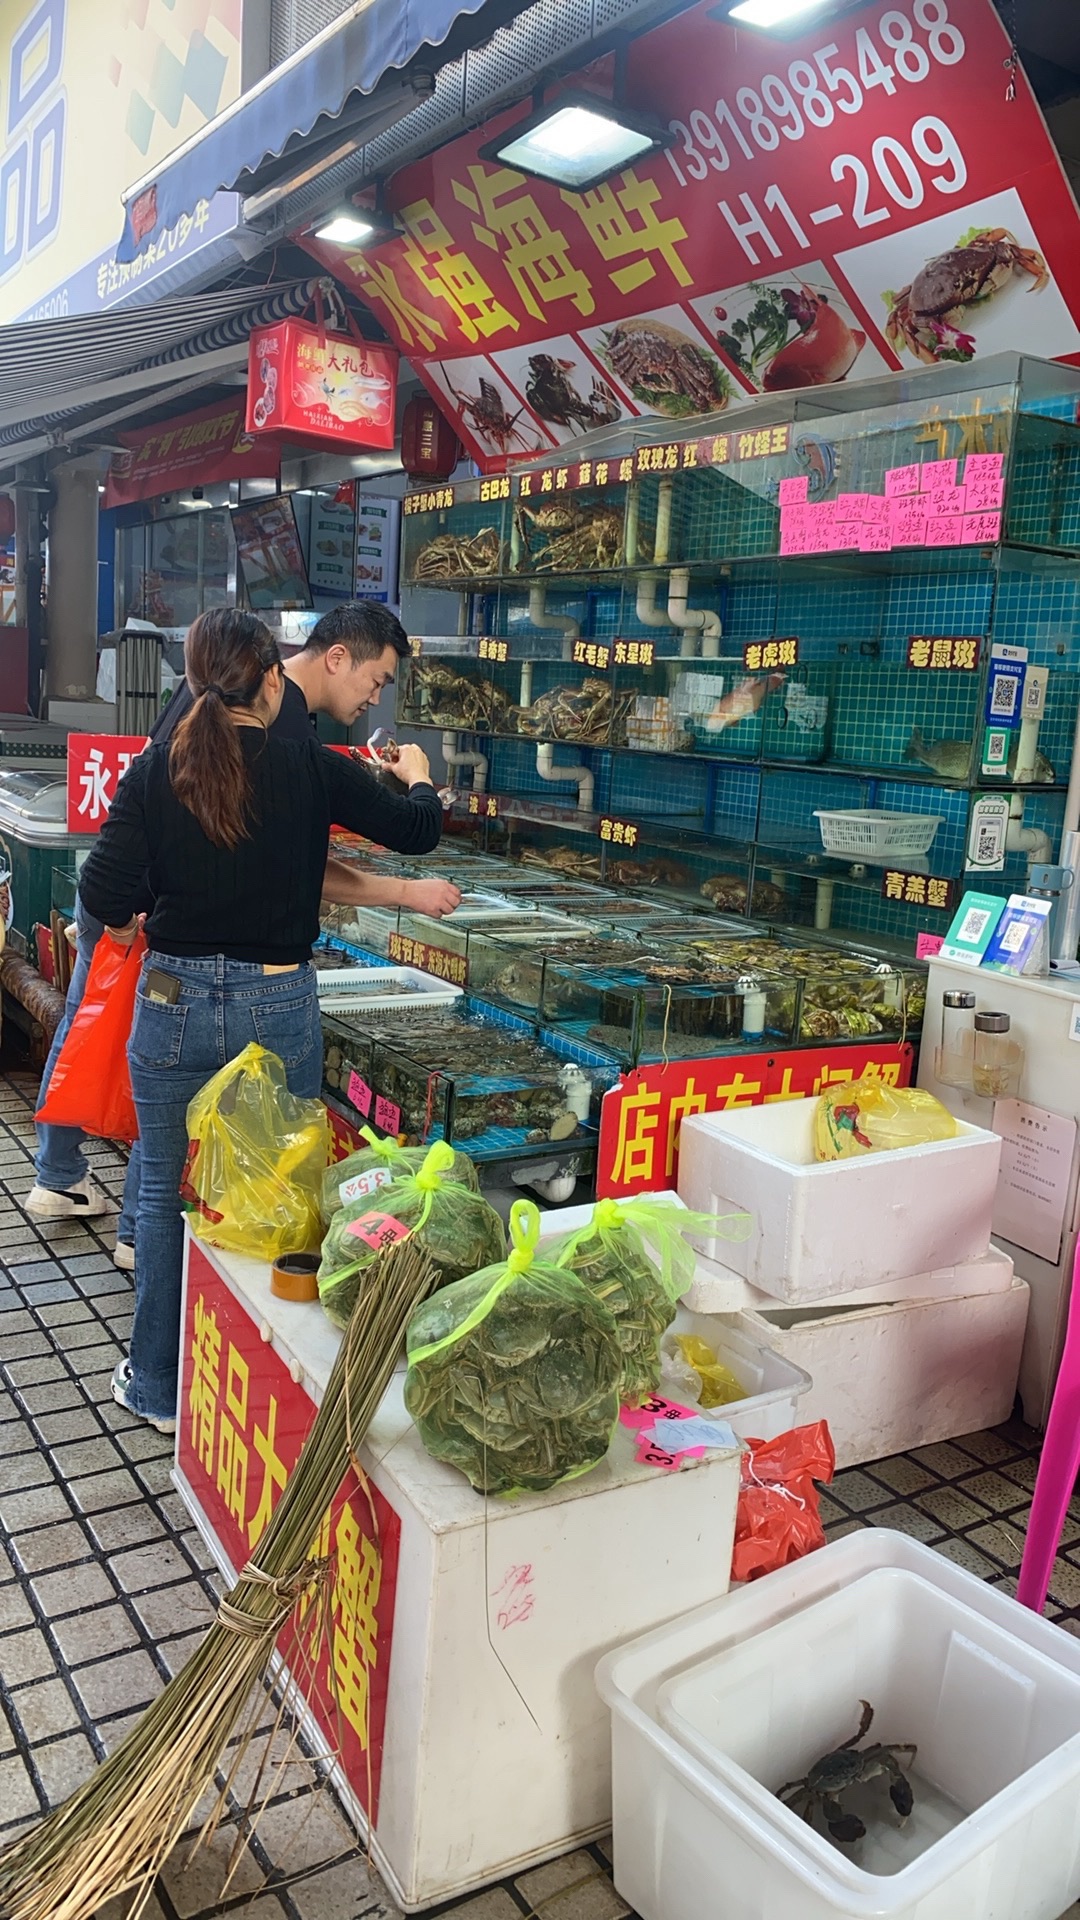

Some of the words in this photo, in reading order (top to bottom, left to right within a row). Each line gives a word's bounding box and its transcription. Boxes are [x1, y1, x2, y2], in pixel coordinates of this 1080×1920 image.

[663, 0, 965, 187] 13918985488
[718, 116, 967, 265] H1-209
[345, 164, 693, 352] 永强海鲜
[328, 353, 375, 378] 大礼包
[310, 417, 345, 431] DALIBAO
[739, 427, 788, 459] 竹蛏王
[637, 445, 679, 471] 玫瑰龙
[480, 478, 511, 500] 古巴龙
[479, 641, 508, 662] 皇帝蟹
[573, 642, 610, 669] 红毛蟹
[614, 642, 653, 665] 东星斑
[746, 640, 796, 670] 老虎斑
[909, 639, 977, 669] 老鼠斑
[600, 819, 638, 847] 富贵虾
[885, 871, 949, 908] 青羔蟹
